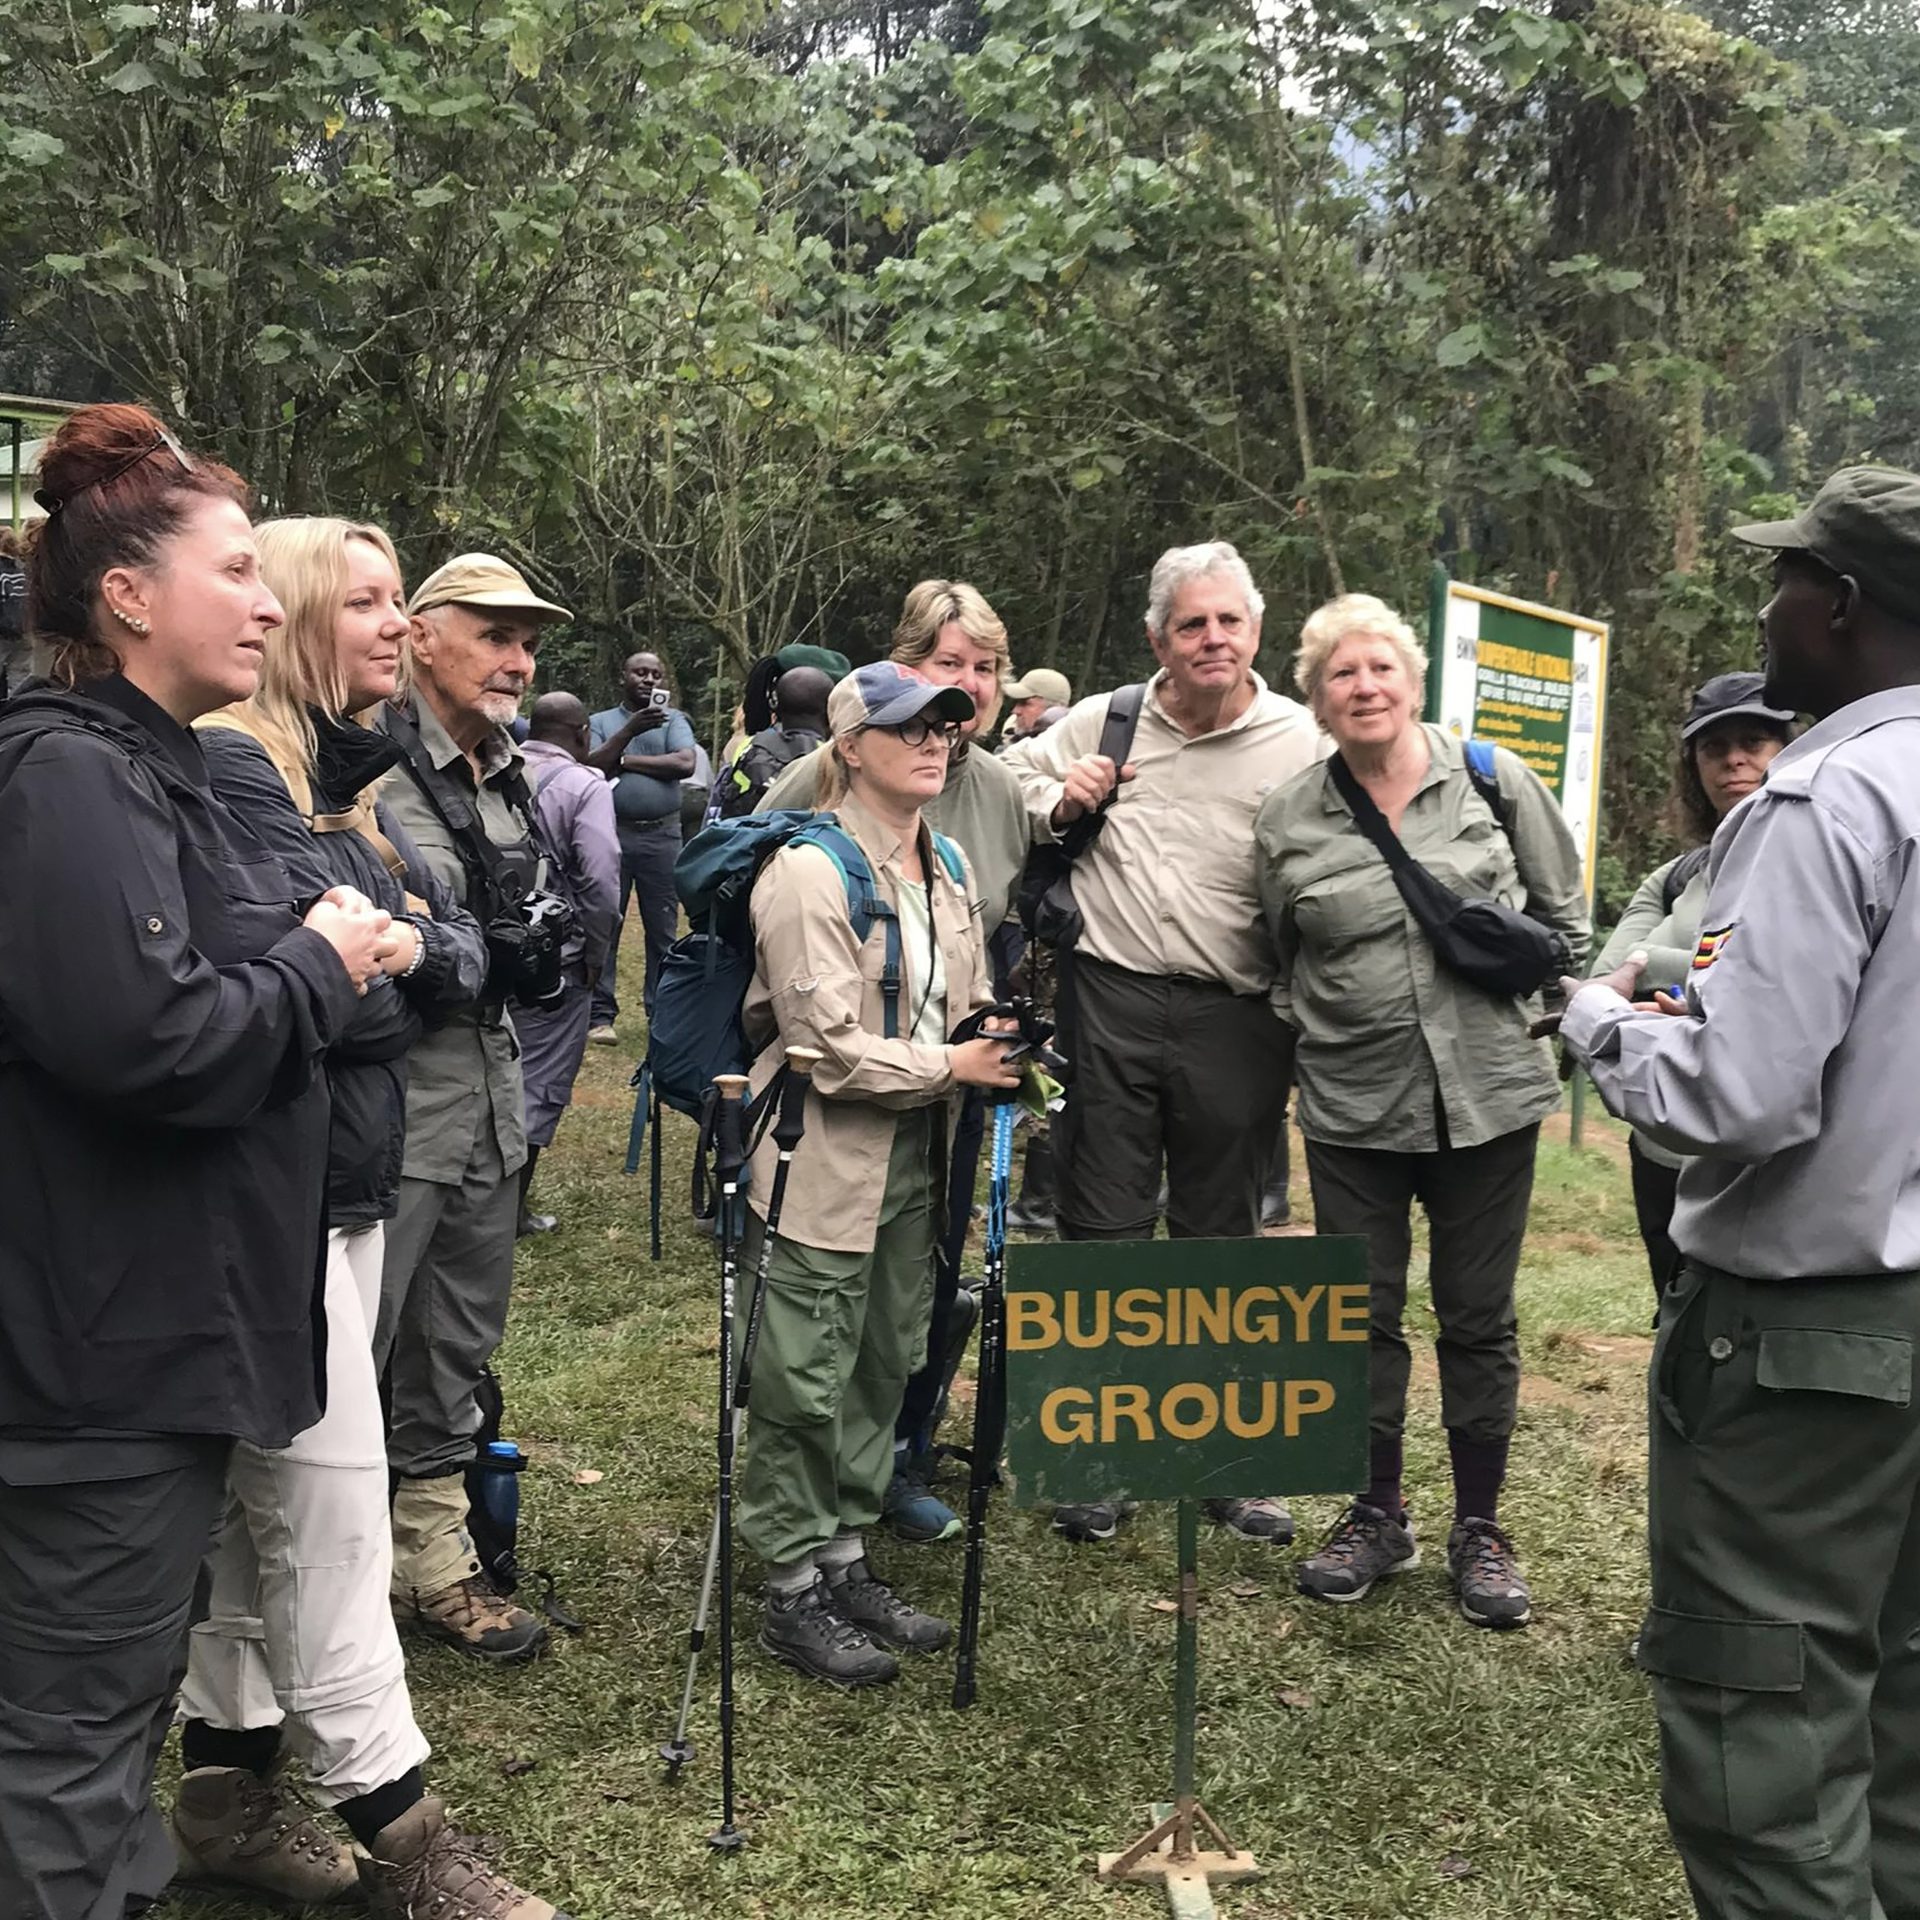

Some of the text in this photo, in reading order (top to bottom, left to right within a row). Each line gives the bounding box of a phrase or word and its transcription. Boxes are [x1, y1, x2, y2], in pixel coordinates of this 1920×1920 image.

[724, 1261, 735, 1318] LEKI
[1006, 1284, 1370, 1351] BUSINGYE
[1040, 1379, 1337, 1445] GROUP
